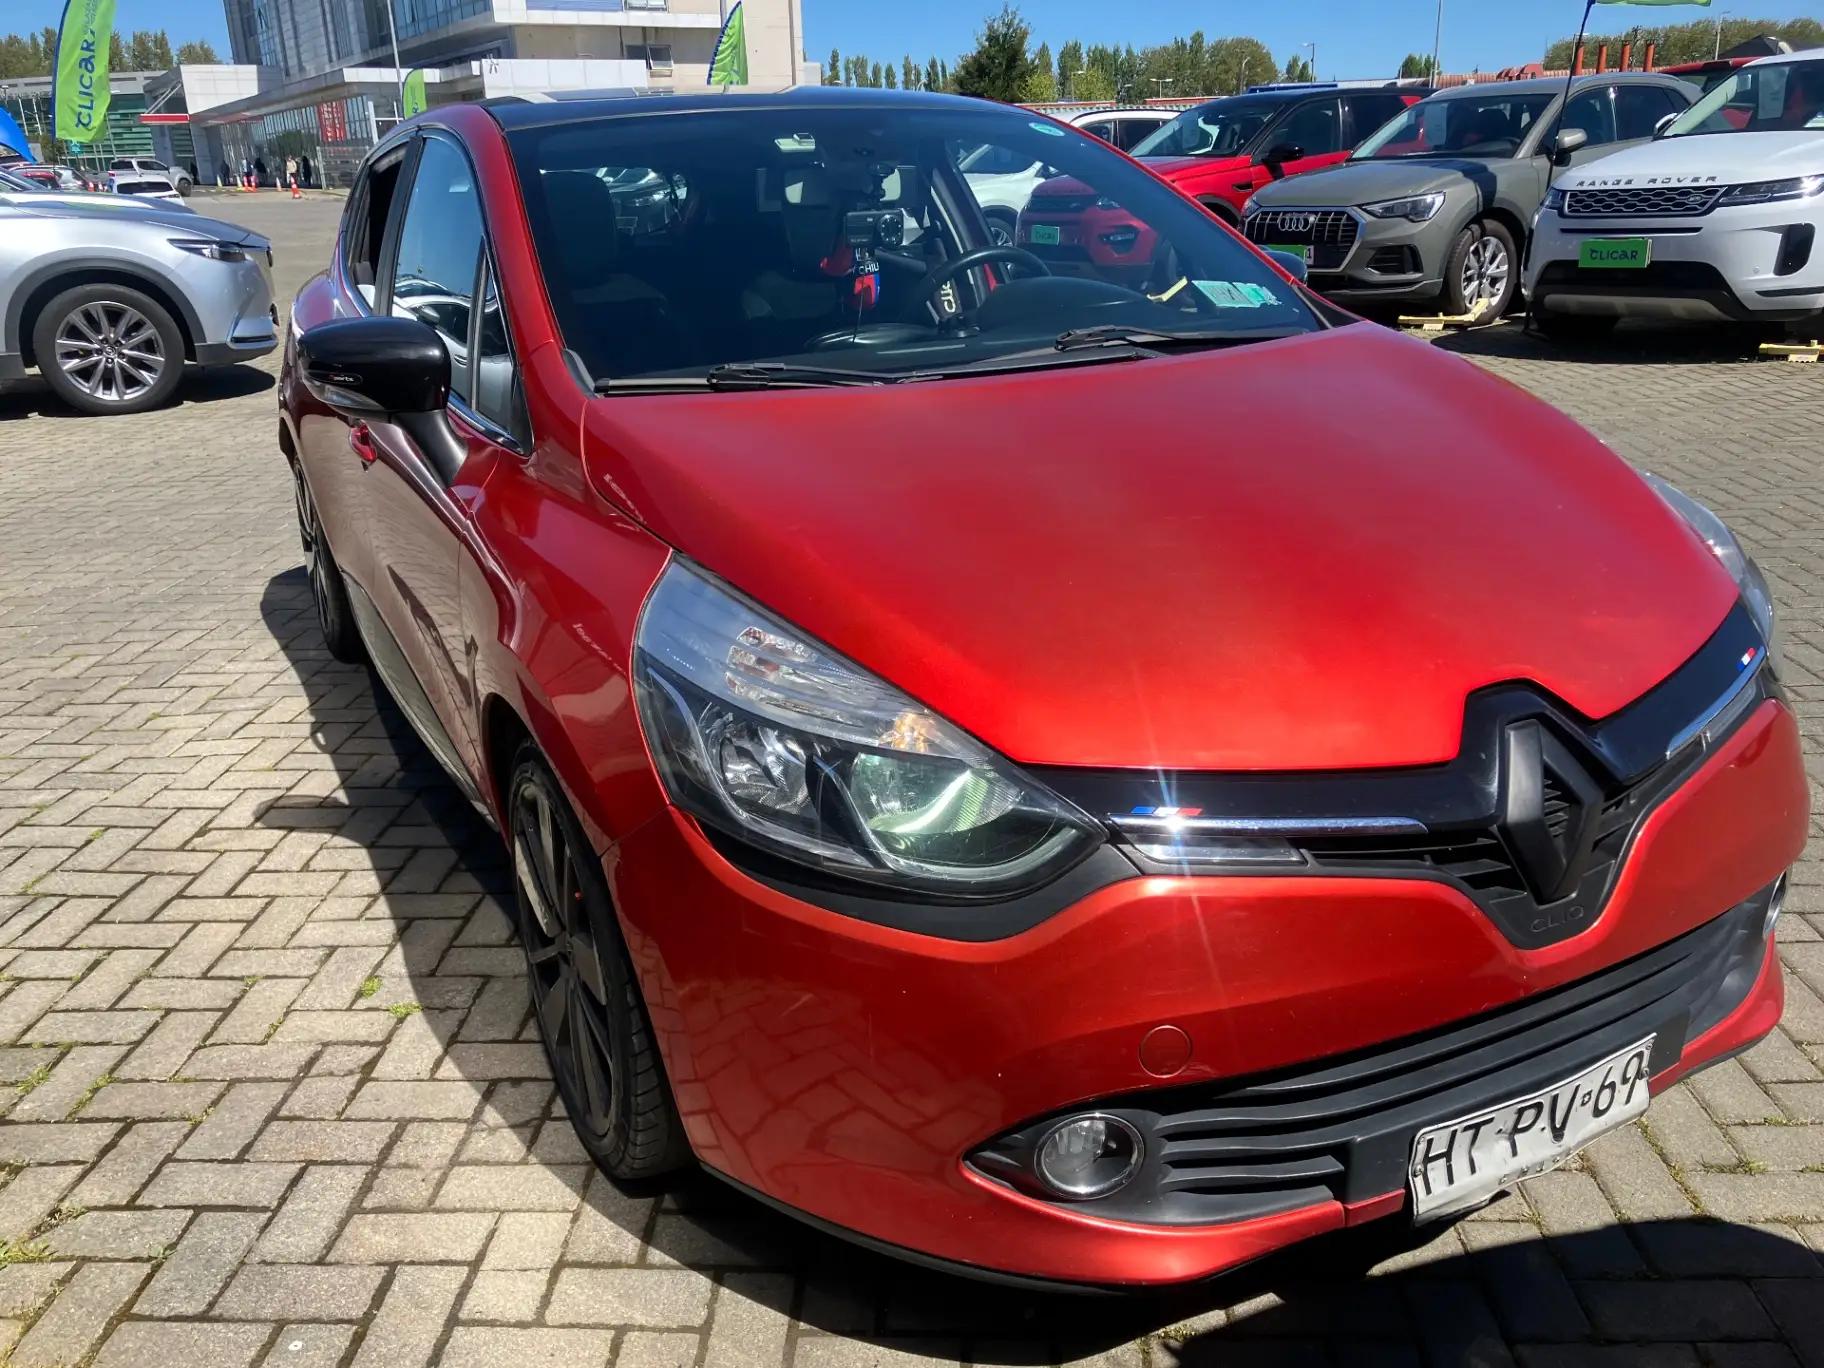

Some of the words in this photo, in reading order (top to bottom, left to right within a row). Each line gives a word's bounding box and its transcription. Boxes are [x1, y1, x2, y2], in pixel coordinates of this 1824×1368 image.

[1576, 178, 1634, 187] RANGE
[1647, 176, 1717, 184] ROVER
[1529, 905, 1584, 932] CLIO
